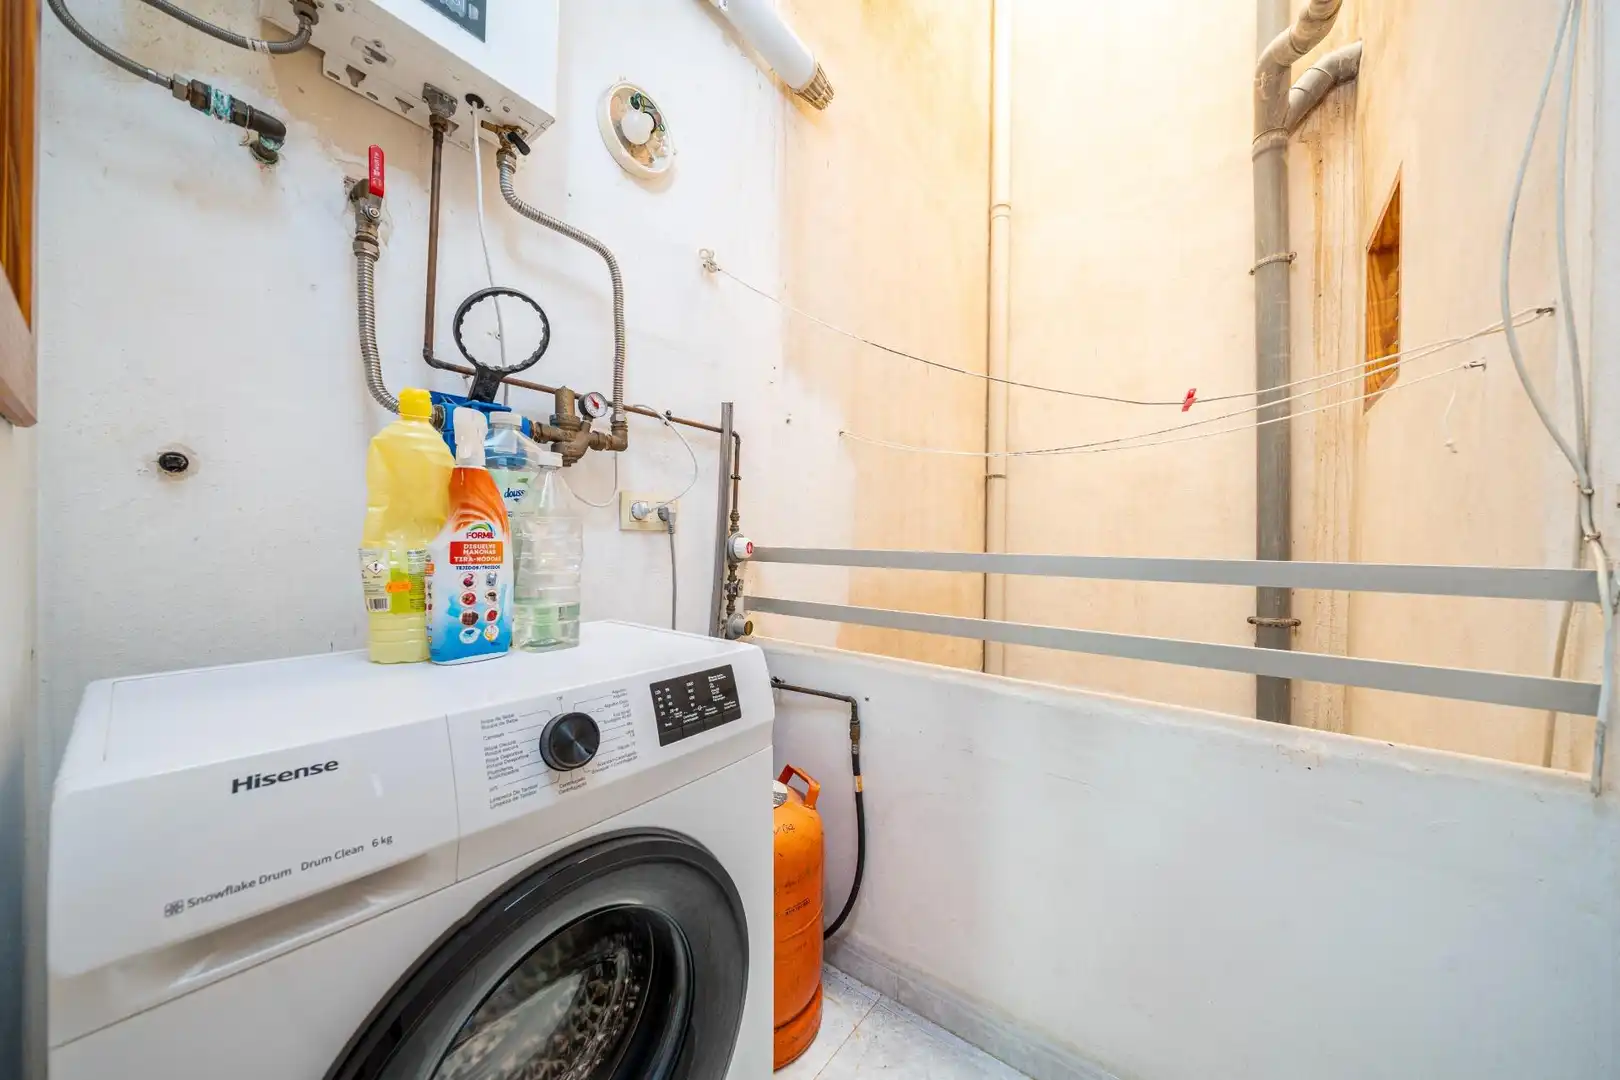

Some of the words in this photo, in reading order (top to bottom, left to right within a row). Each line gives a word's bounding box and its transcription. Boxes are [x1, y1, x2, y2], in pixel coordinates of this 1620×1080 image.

[466, 531, 494, 539] FORMIL
[231, 760, 340, 794] Hisense
[187, 880, 256, 909] Snowflake
[258, 867, 292, 885] Drum
[300, 856, 332, 872] Drum
[334, 844, 364, 860] Clean
[372, 838, 379, 848] 6
[380, 834, 394, 846] kg
